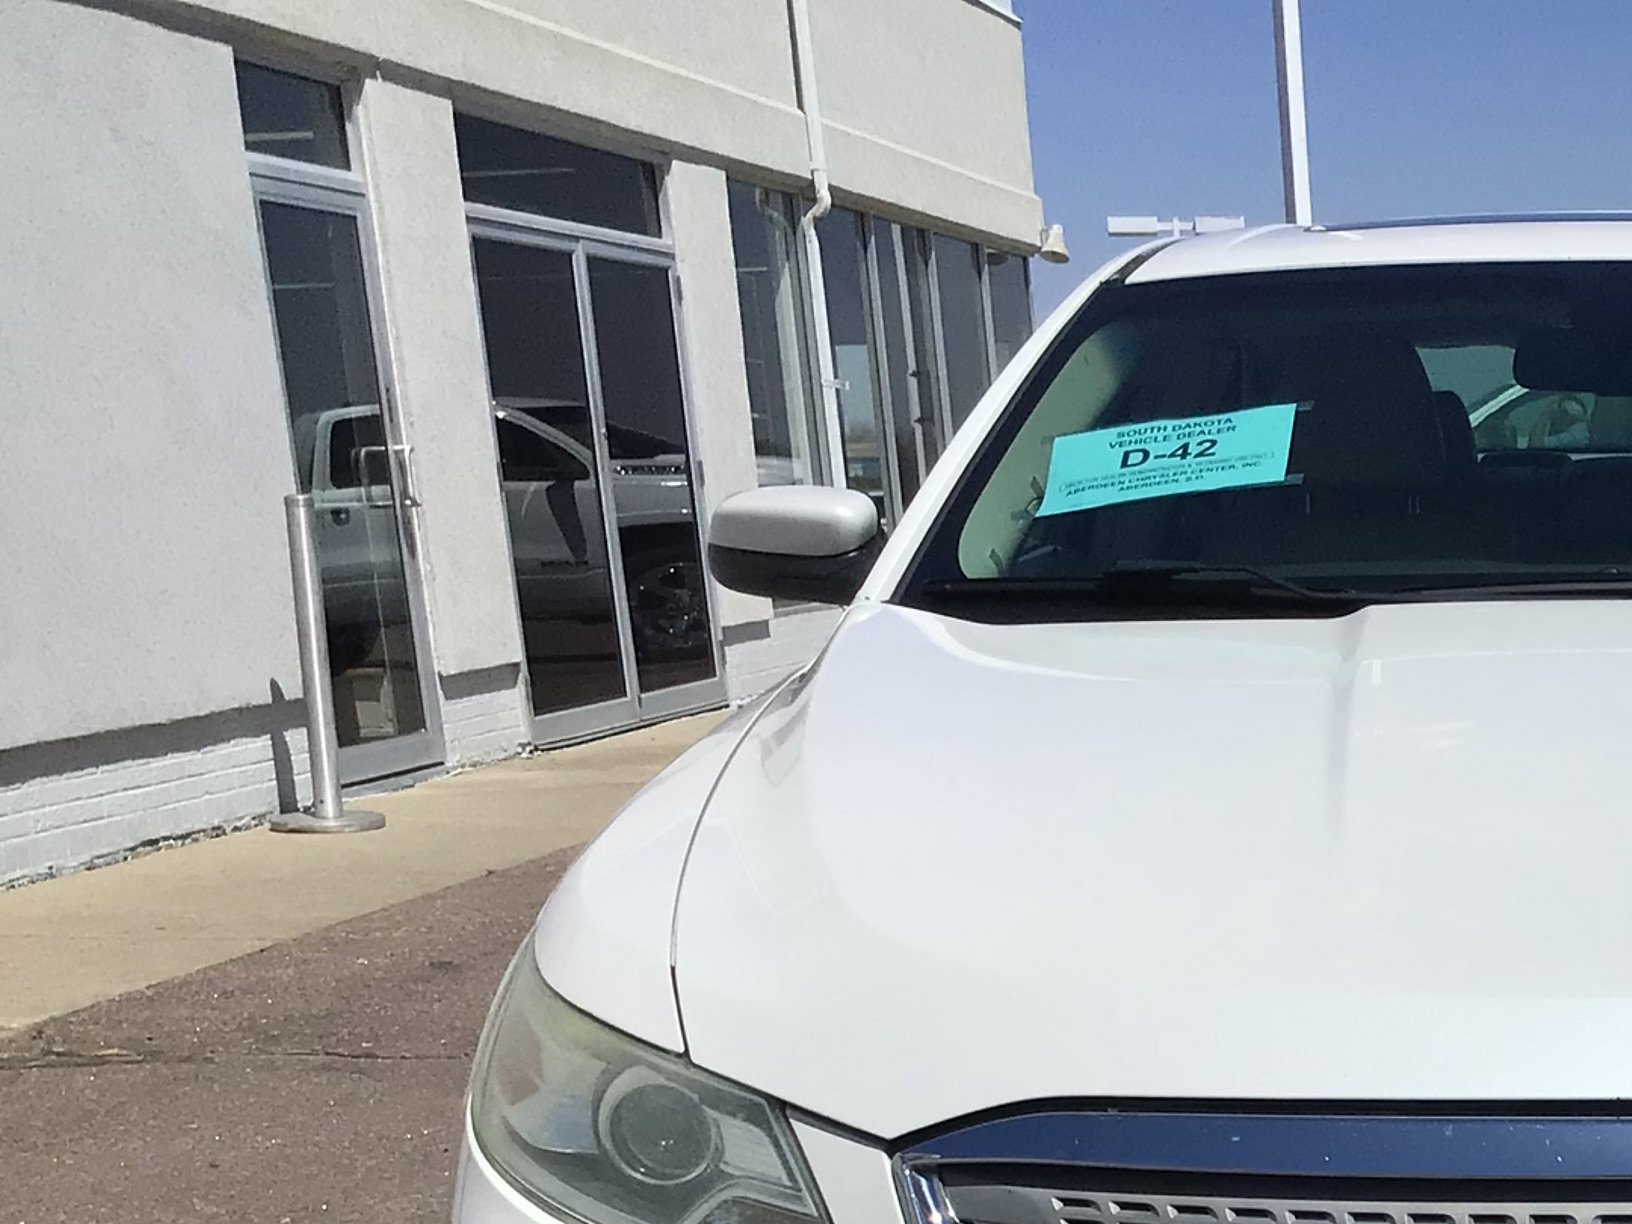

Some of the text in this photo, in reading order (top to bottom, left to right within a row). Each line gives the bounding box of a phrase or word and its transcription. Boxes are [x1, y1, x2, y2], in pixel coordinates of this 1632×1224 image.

[1109, 425, 1236, 449] VEHICLE DEALER
[1116, 417, 1233, 439] SOUTH DAKOTA
[1120, 439, 1218, 469] D-42
[1065, 480, 1126, 497] ABERDEEN
[1128, 470, 1188, 484] CHRYSLER
